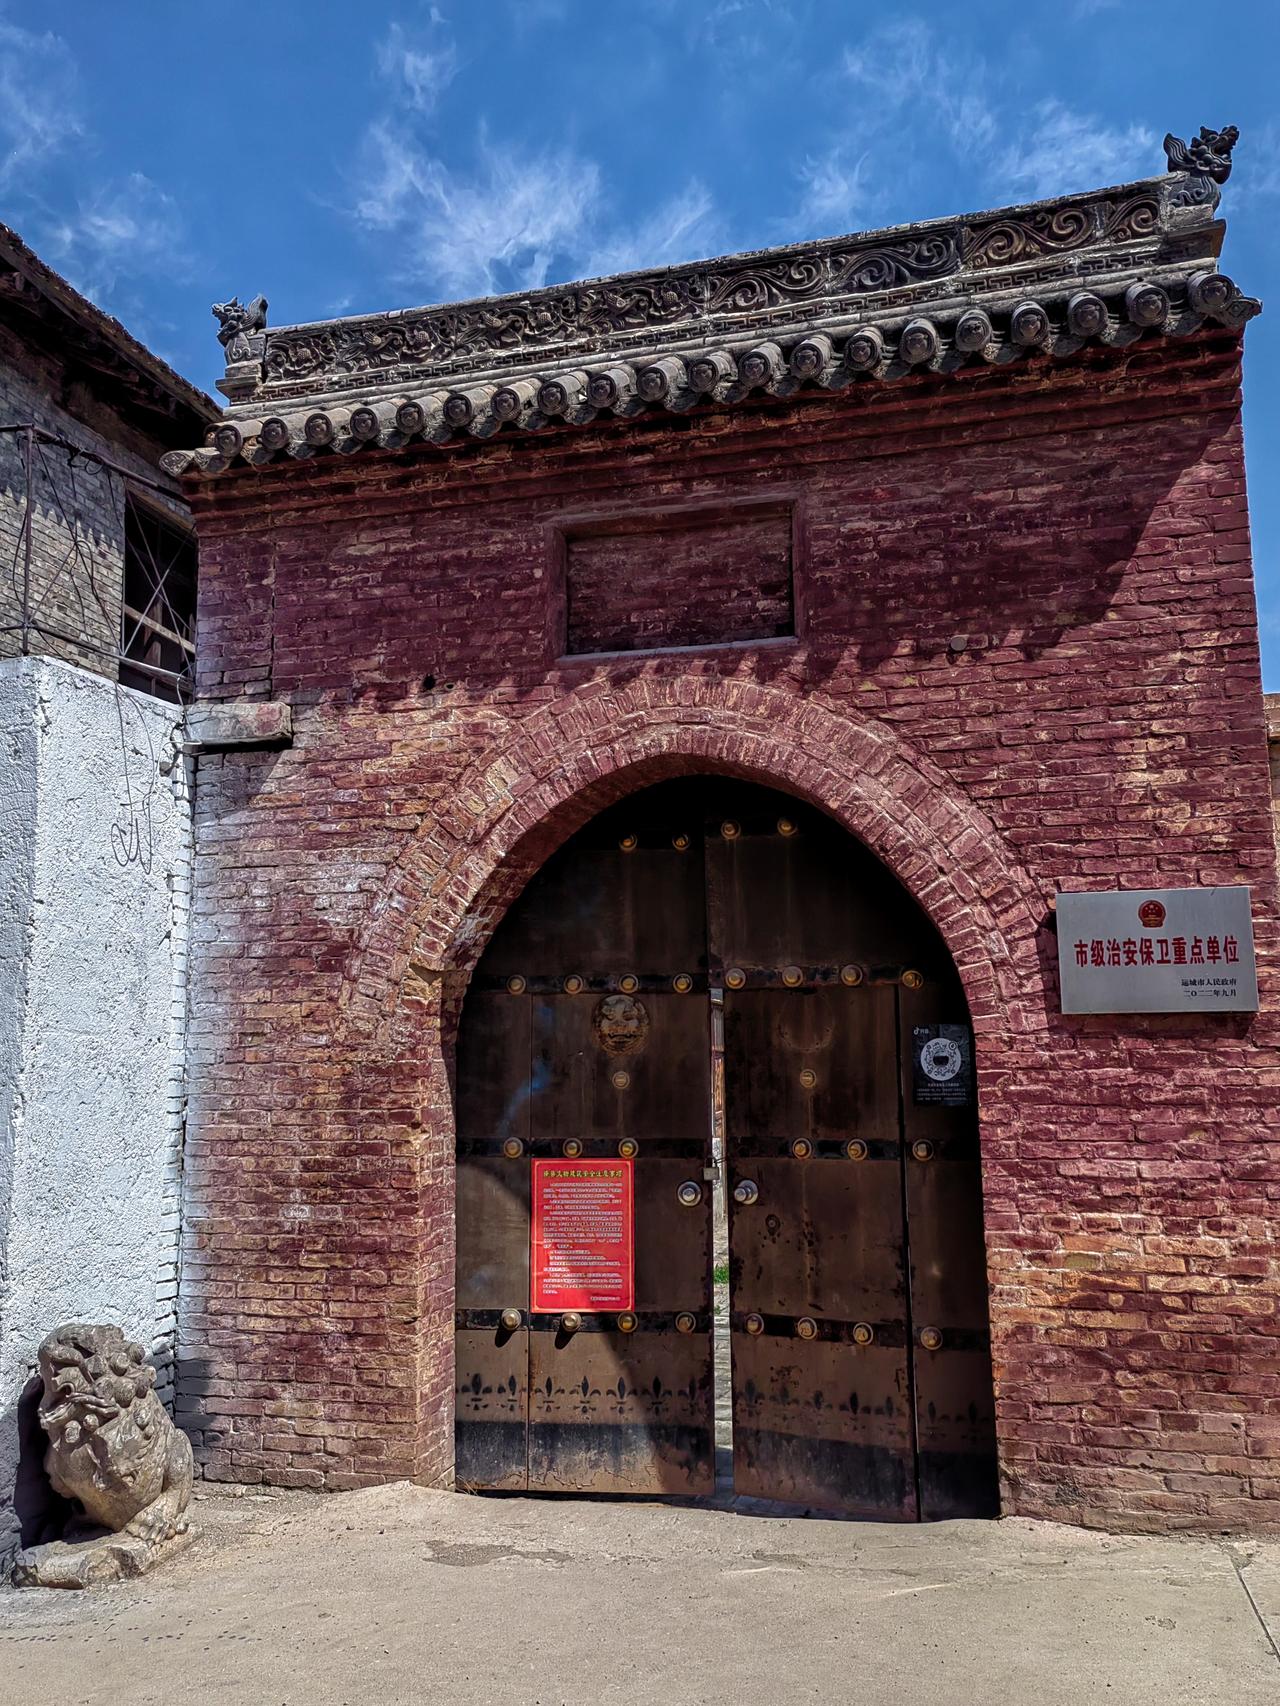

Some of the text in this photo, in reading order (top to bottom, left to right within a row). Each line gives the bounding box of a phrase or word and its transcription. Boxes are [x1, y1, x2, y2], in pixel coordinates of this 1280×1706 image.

[1074, 935, 1240, 967] 市级治安保卫重点单位
[1181, 978, 1237, 986] 运城市人民政府
